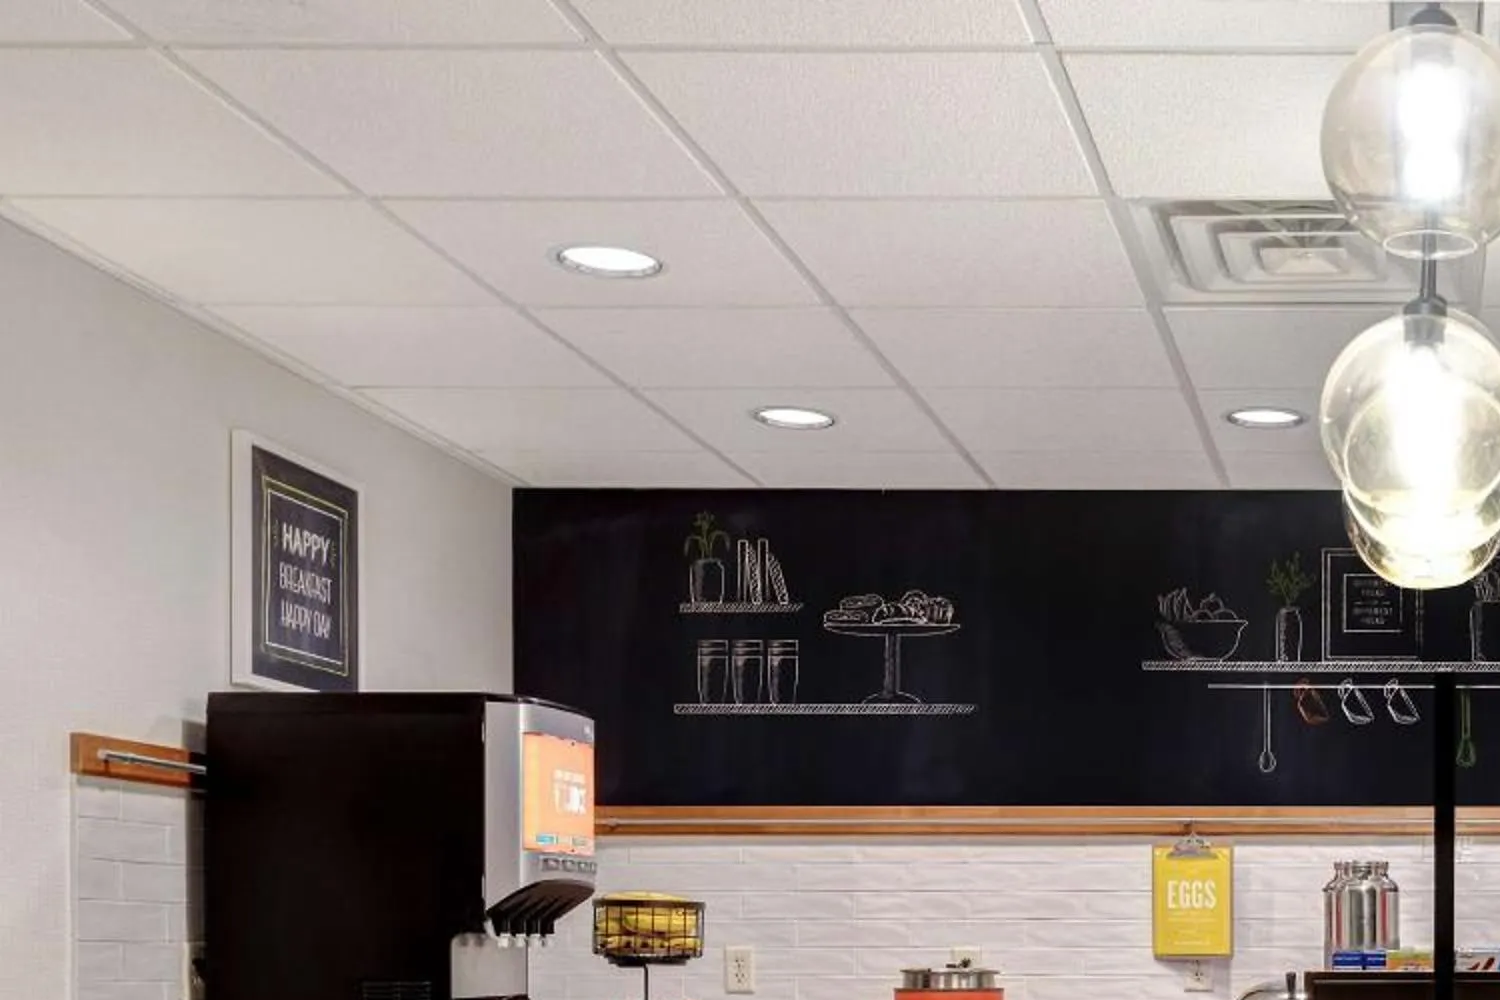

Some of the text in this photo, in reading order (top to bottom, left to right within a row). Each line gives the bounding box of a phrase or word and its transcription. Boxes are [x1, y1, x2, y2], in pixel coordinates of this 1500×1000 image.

[281, 521, 331, 565] HAPPY
[279, 561, 333, 605] BREAKFAST
[1166, 879, 1217, 910] EGGS
